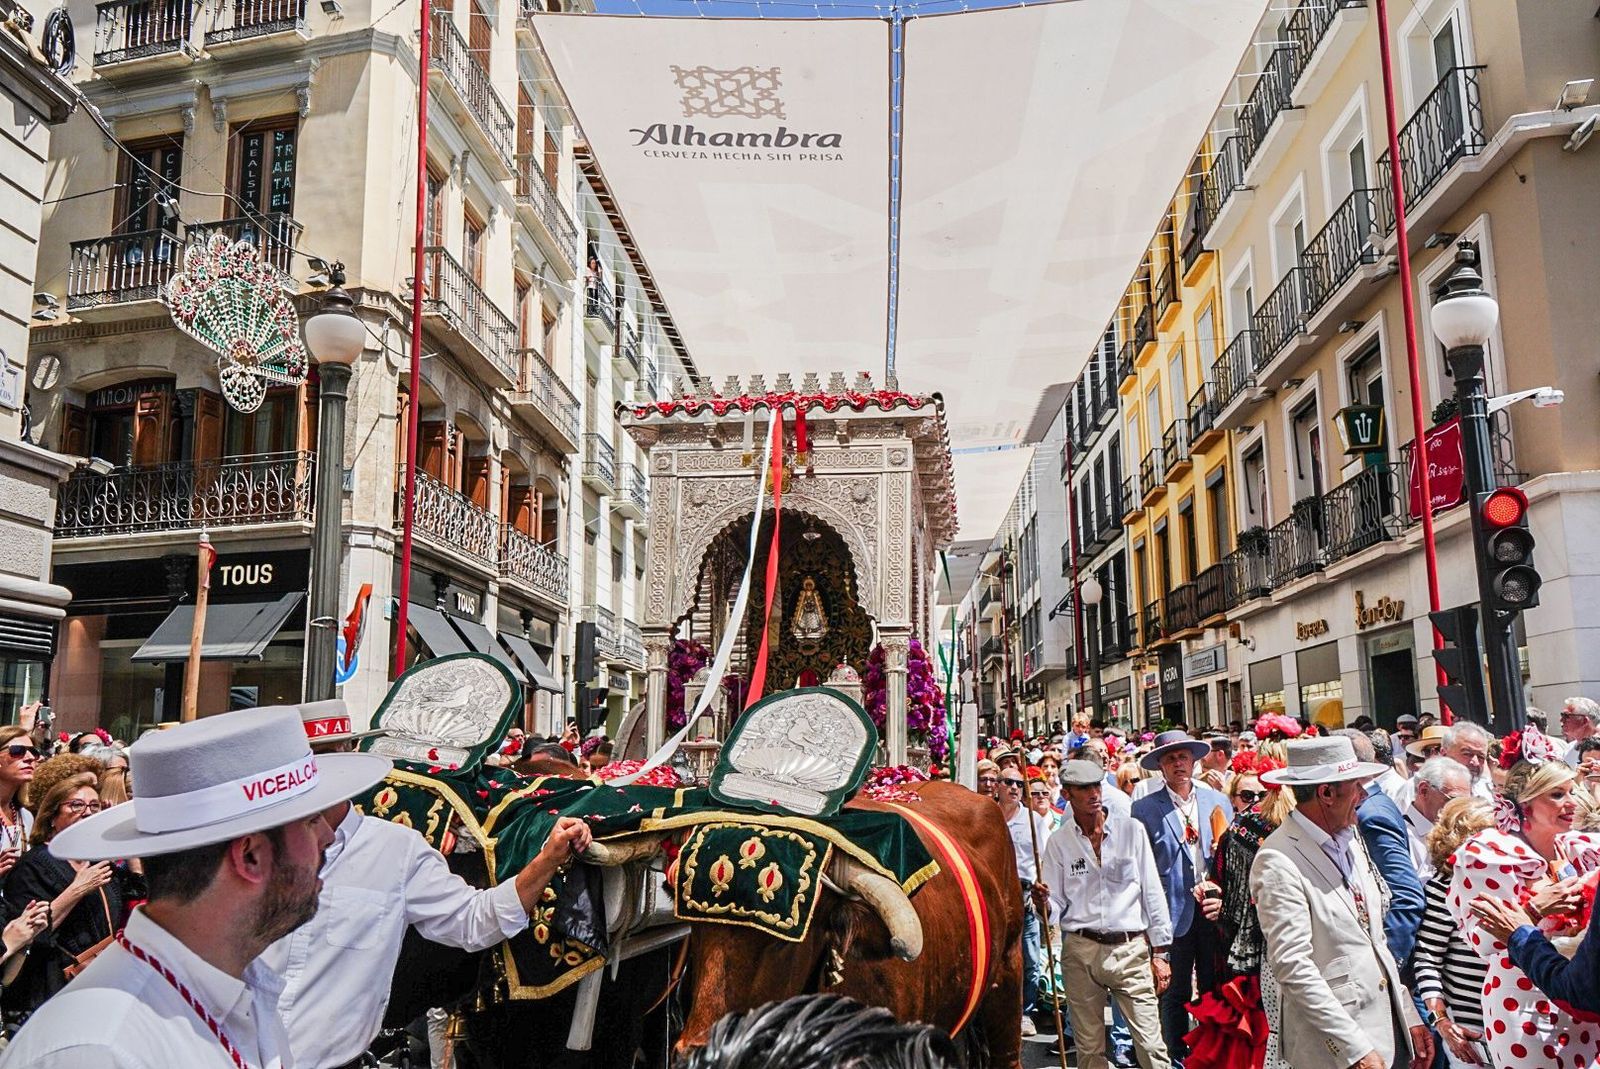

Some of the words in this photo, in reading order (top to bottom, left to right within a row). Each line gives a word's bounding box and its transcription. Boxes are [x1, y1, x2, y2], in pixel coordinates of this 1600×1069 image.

[629, 124, 842, 148] Alhambra
[644, 150, 708, 159] CERVEZA
[713, 152, 761, 160] HECHA
[767, 153, 791, 161] SIN
[800, 153, 843, 161] PRISA
[220, 564, 272, 586] TOUS
[456, 592, 475, 615] TOUS
[306, 720, 351, 736] NAD
